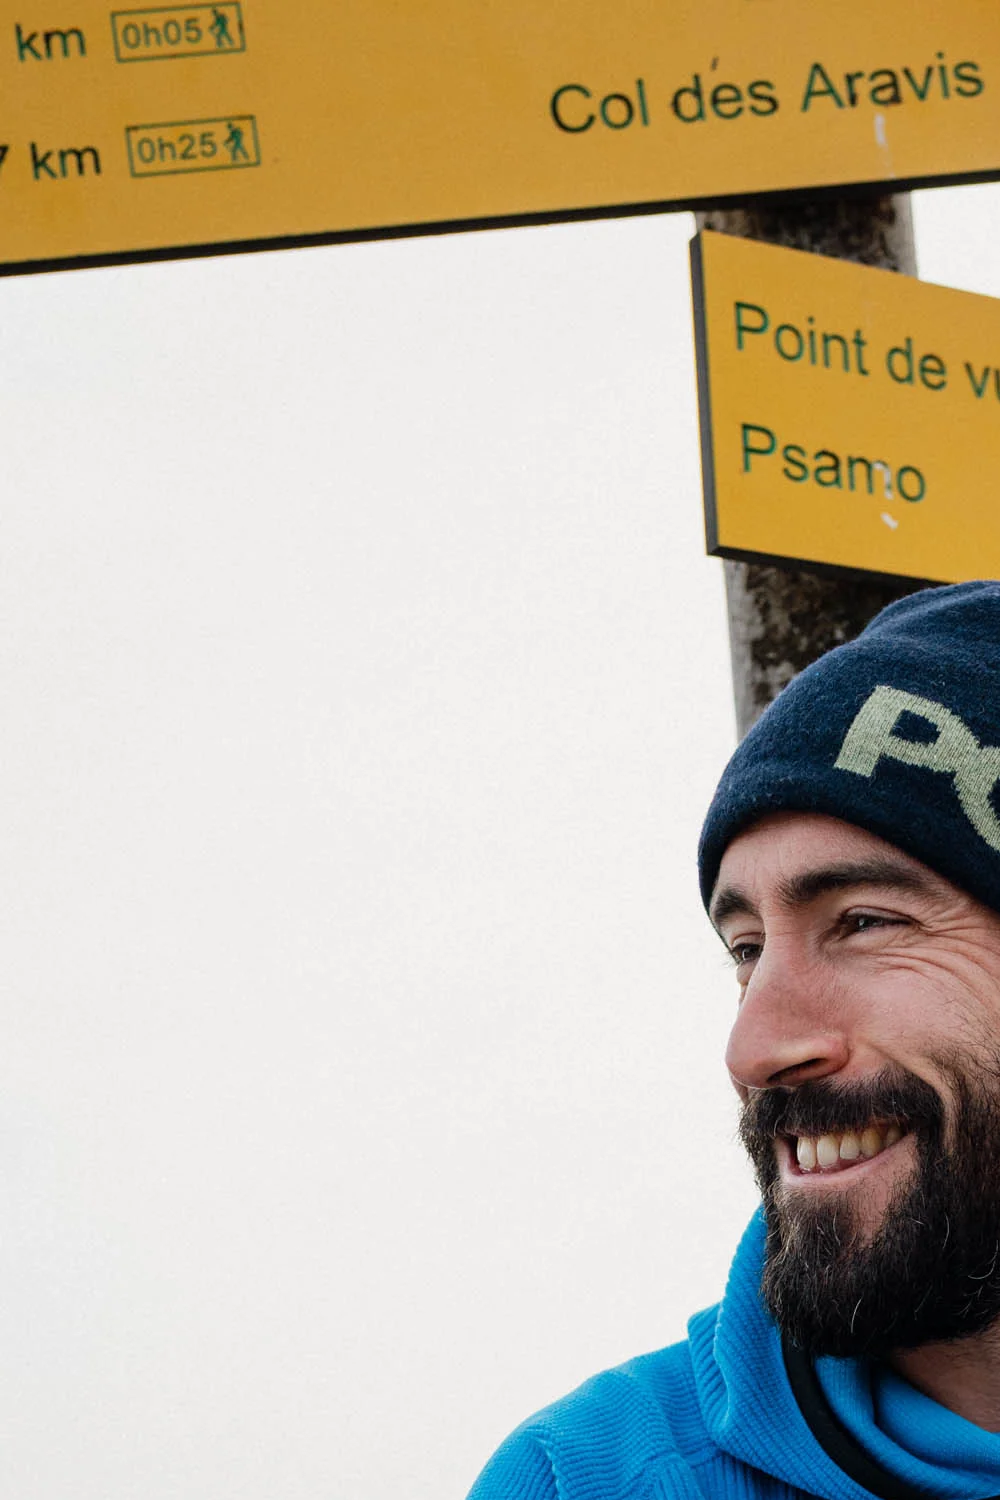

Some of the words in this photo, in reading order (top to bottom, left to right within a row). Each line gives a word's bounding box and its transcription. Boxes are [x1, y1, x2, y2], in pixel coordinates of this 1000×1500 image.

[15, 22, 87, 64] km
[121, 15, 203, 51] 0h05
[550, 79, 649, 134] Col
[801, 51, 985, 112] Aravis
[30, 142, 102, 181] km
[136, 132, 218, 165] 0h25
[733, 300, 869, 376] Point
[886, 338, 947, 390] de
[741, 422, 926, 503] Psamo
